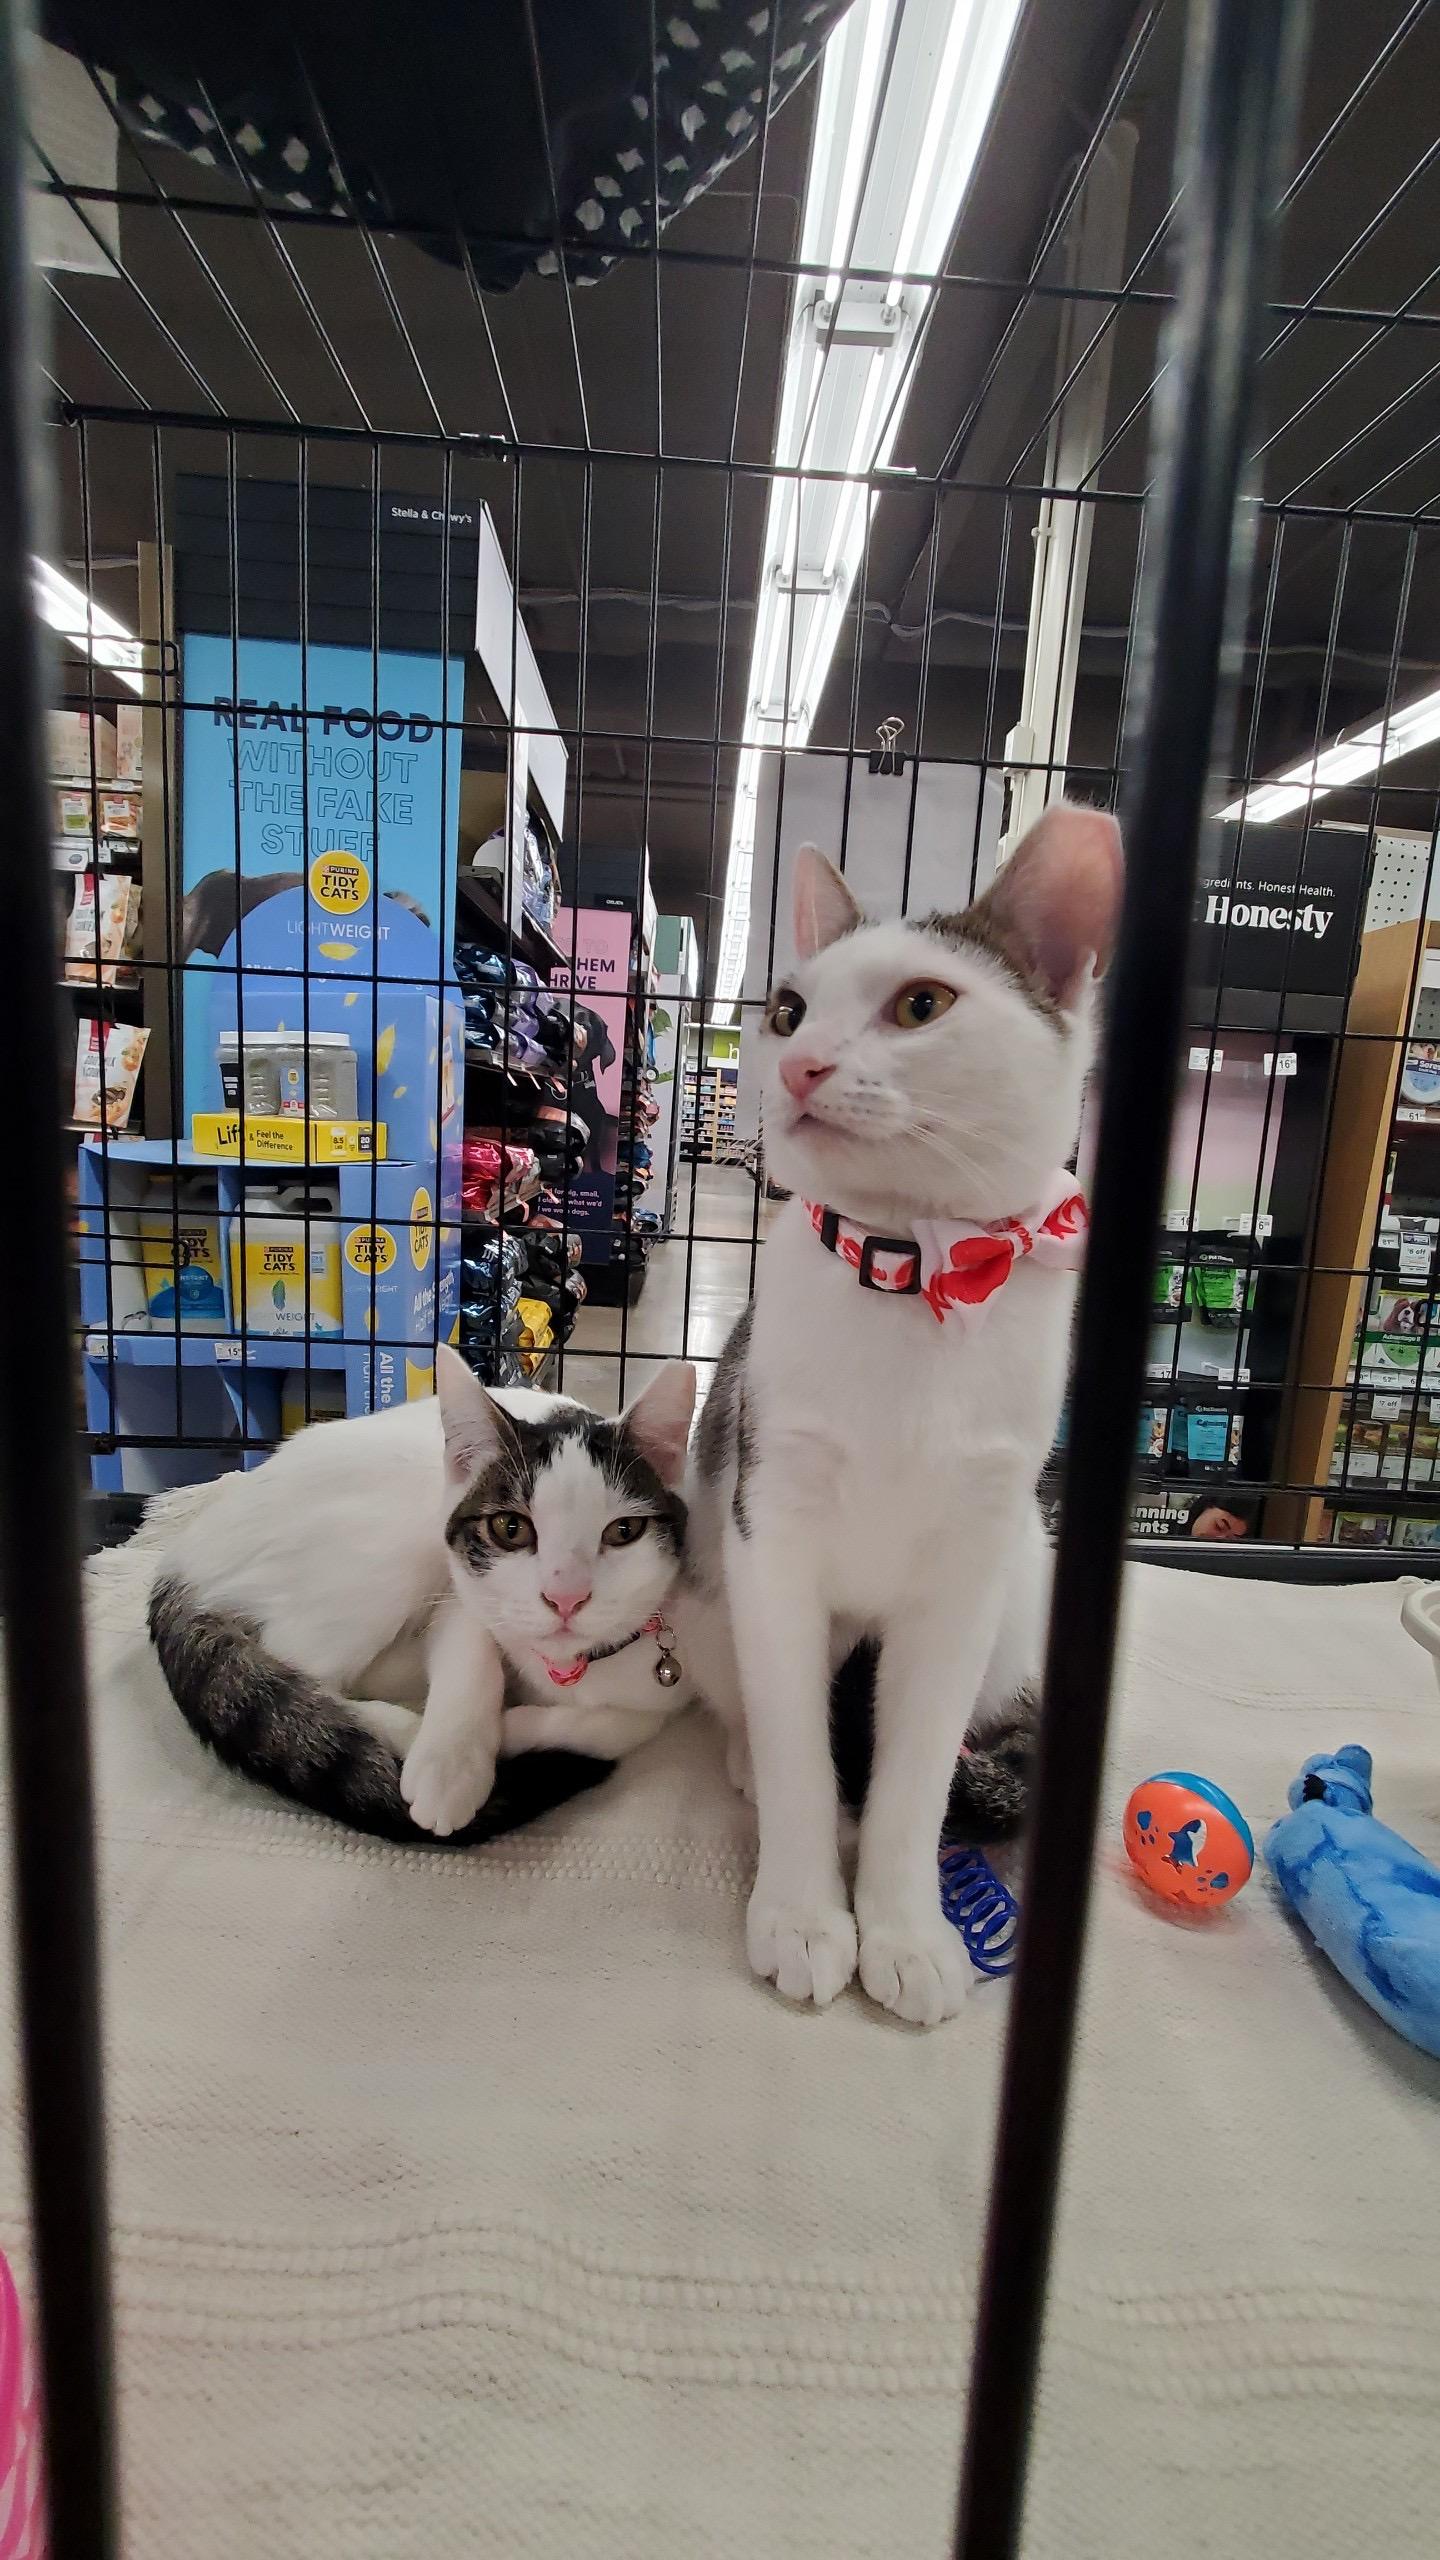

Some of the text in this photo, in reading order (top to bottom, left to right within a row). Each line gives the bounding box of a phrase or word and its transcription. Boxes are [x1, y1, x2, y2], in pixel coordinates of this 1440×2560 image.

[391, 507, 472, 524] Stella & Chwy's
[213, 696, 434, 743] REAL FOOD
[227, 738, 418, 784] WITHOUT
[229, 779, 414, 825] THE FAKE
[261, 823, 380, 862] STUFF
[329, 866, 359, 876] PURINA
[322, 874, 358, 888] TIDY
[1203, 878, 1336, 898] gredints. Honest Health.
[320, 887, 359, 901] CATS
[1204, 895, 1334, 939] Honesty
[577, 957, 615, 973] HEM
[550, 973, 597, 990] HRVE
[217, 1125, 240, 1145] Lif
[256, 1130, 284, 1140] Feel the
[256, 1139, 293, 1151] Difference
[579, 1190, 600, 1198] small,
[571, 1208, 590, 1216] dogs.
[264, 1253, 294, 1263] TIDY
[263, 1262, 296, 1272] CATS
[276, 1312, 315, 1321] WEIGT
[379, 1351, 395, 1404] All the
[1130, 1520, 1169, 1534] ents
